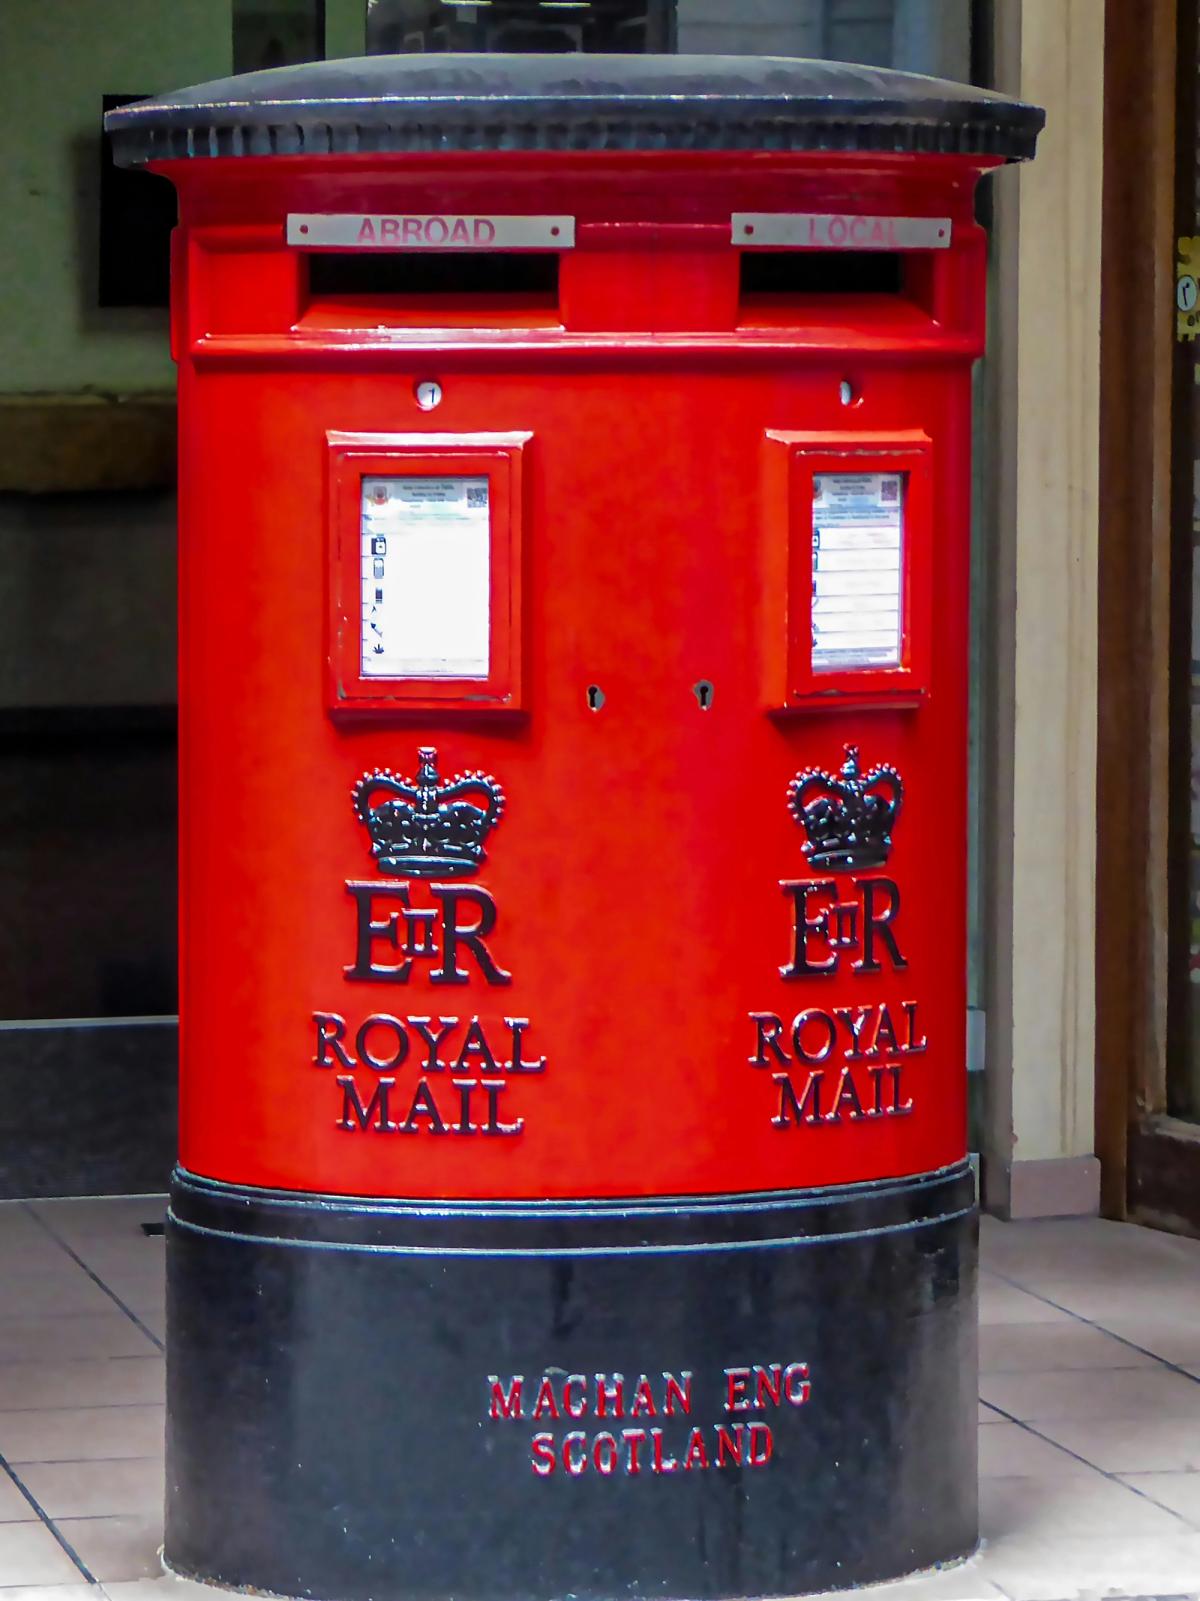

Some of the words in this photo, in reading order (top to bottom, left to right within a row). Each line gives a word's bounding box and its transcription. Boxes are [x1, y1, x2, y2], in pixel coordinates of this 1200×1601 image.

[356, 217, 496, 244] ABROAD
[808, 216, 897, 246] LOCAL
[312, 1011, 547, 1072] ROYAL
[747, 1000, 928, 1066] ROYAL
[336, 1074, 525, 1136] MAIL
[770, 1063, 913, 1126] MAIL
[487, 1371, 693, 1420] MACHAN
[723, 1362, 811, 1411] ENG
[531, 1421, 773, 1476] SCOTLAND
